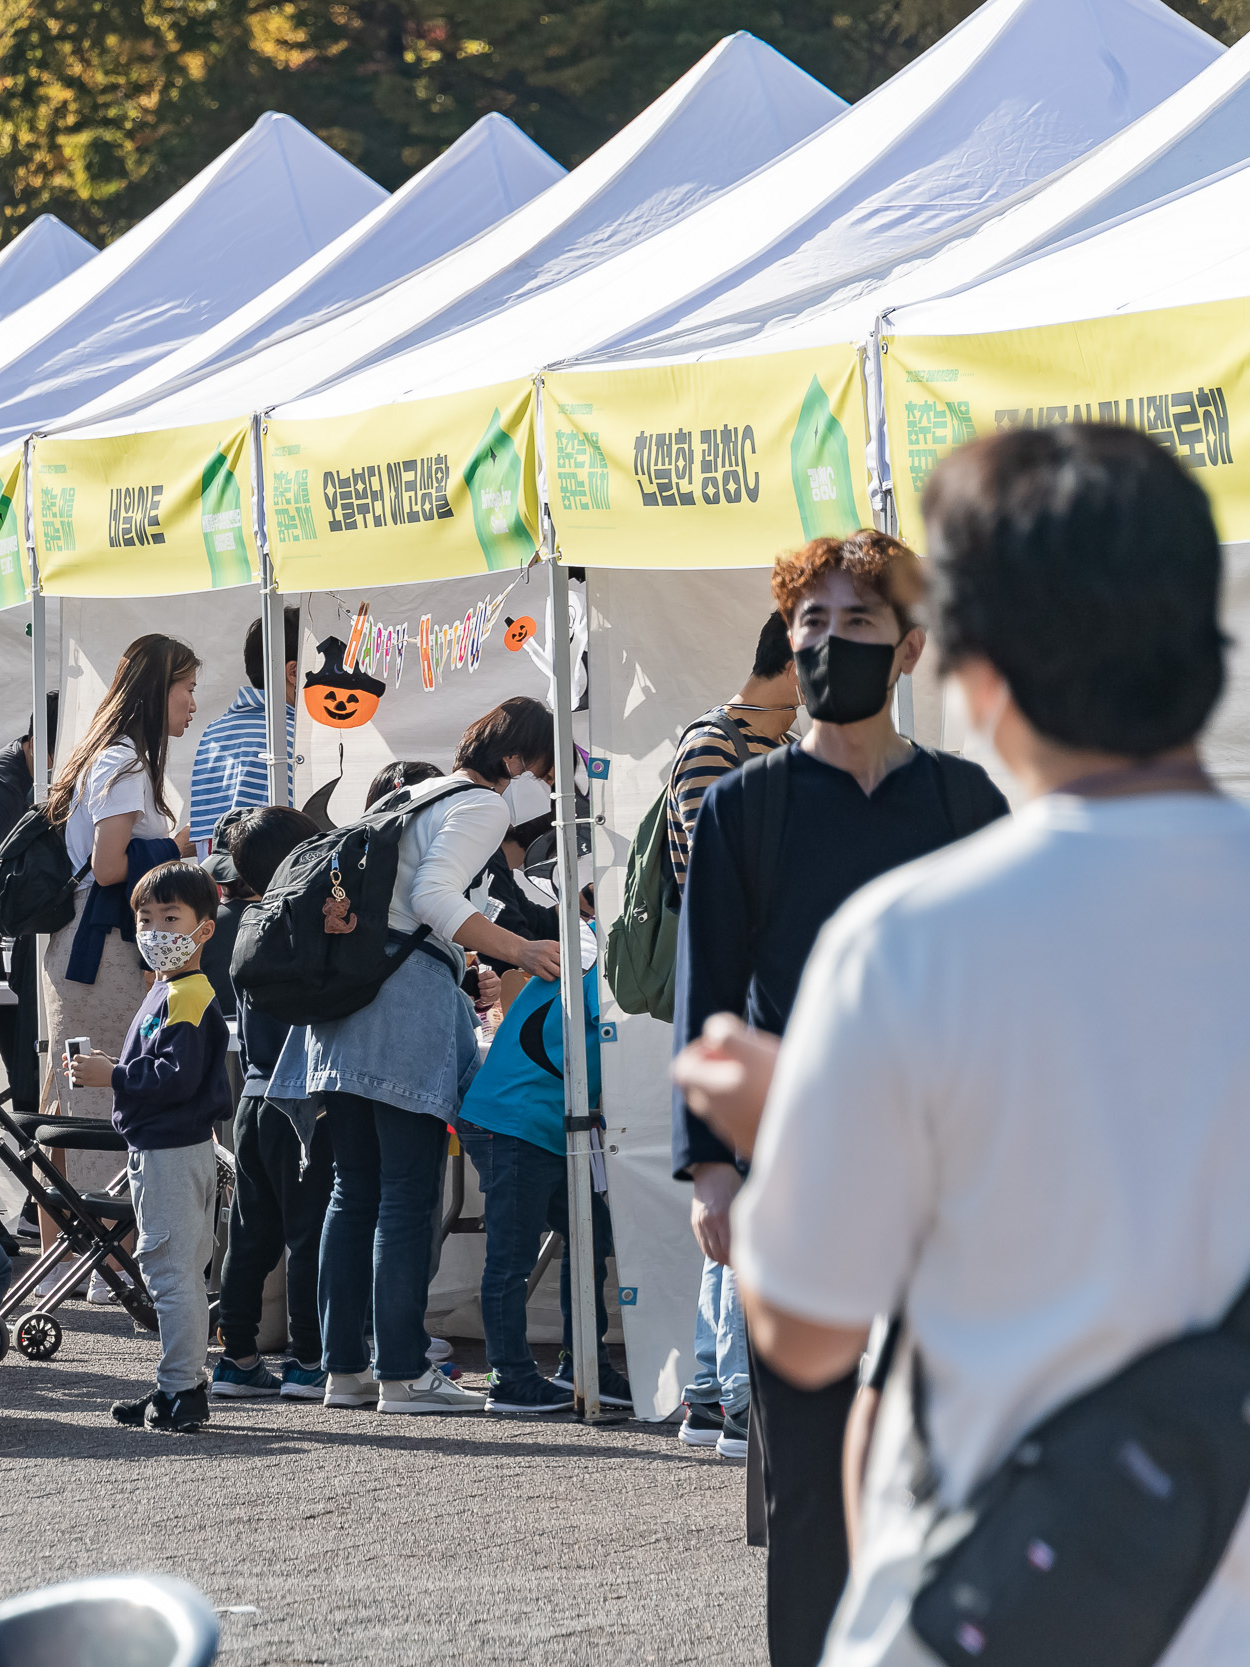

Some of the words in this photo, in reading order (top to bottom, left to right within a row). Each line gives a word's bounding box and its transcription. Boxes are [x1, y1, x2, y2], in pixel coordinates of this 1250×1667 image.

[323, 463, 387, 533] 오늘부터
[386, 453, 455, 525] 에코생활
[634, 428, 696, 507] 친절한
[700, 423, 760, 505] 광청C
[108, 484, 166, 548] 네일아트
[343, 600, 407, 689] HAPPY
